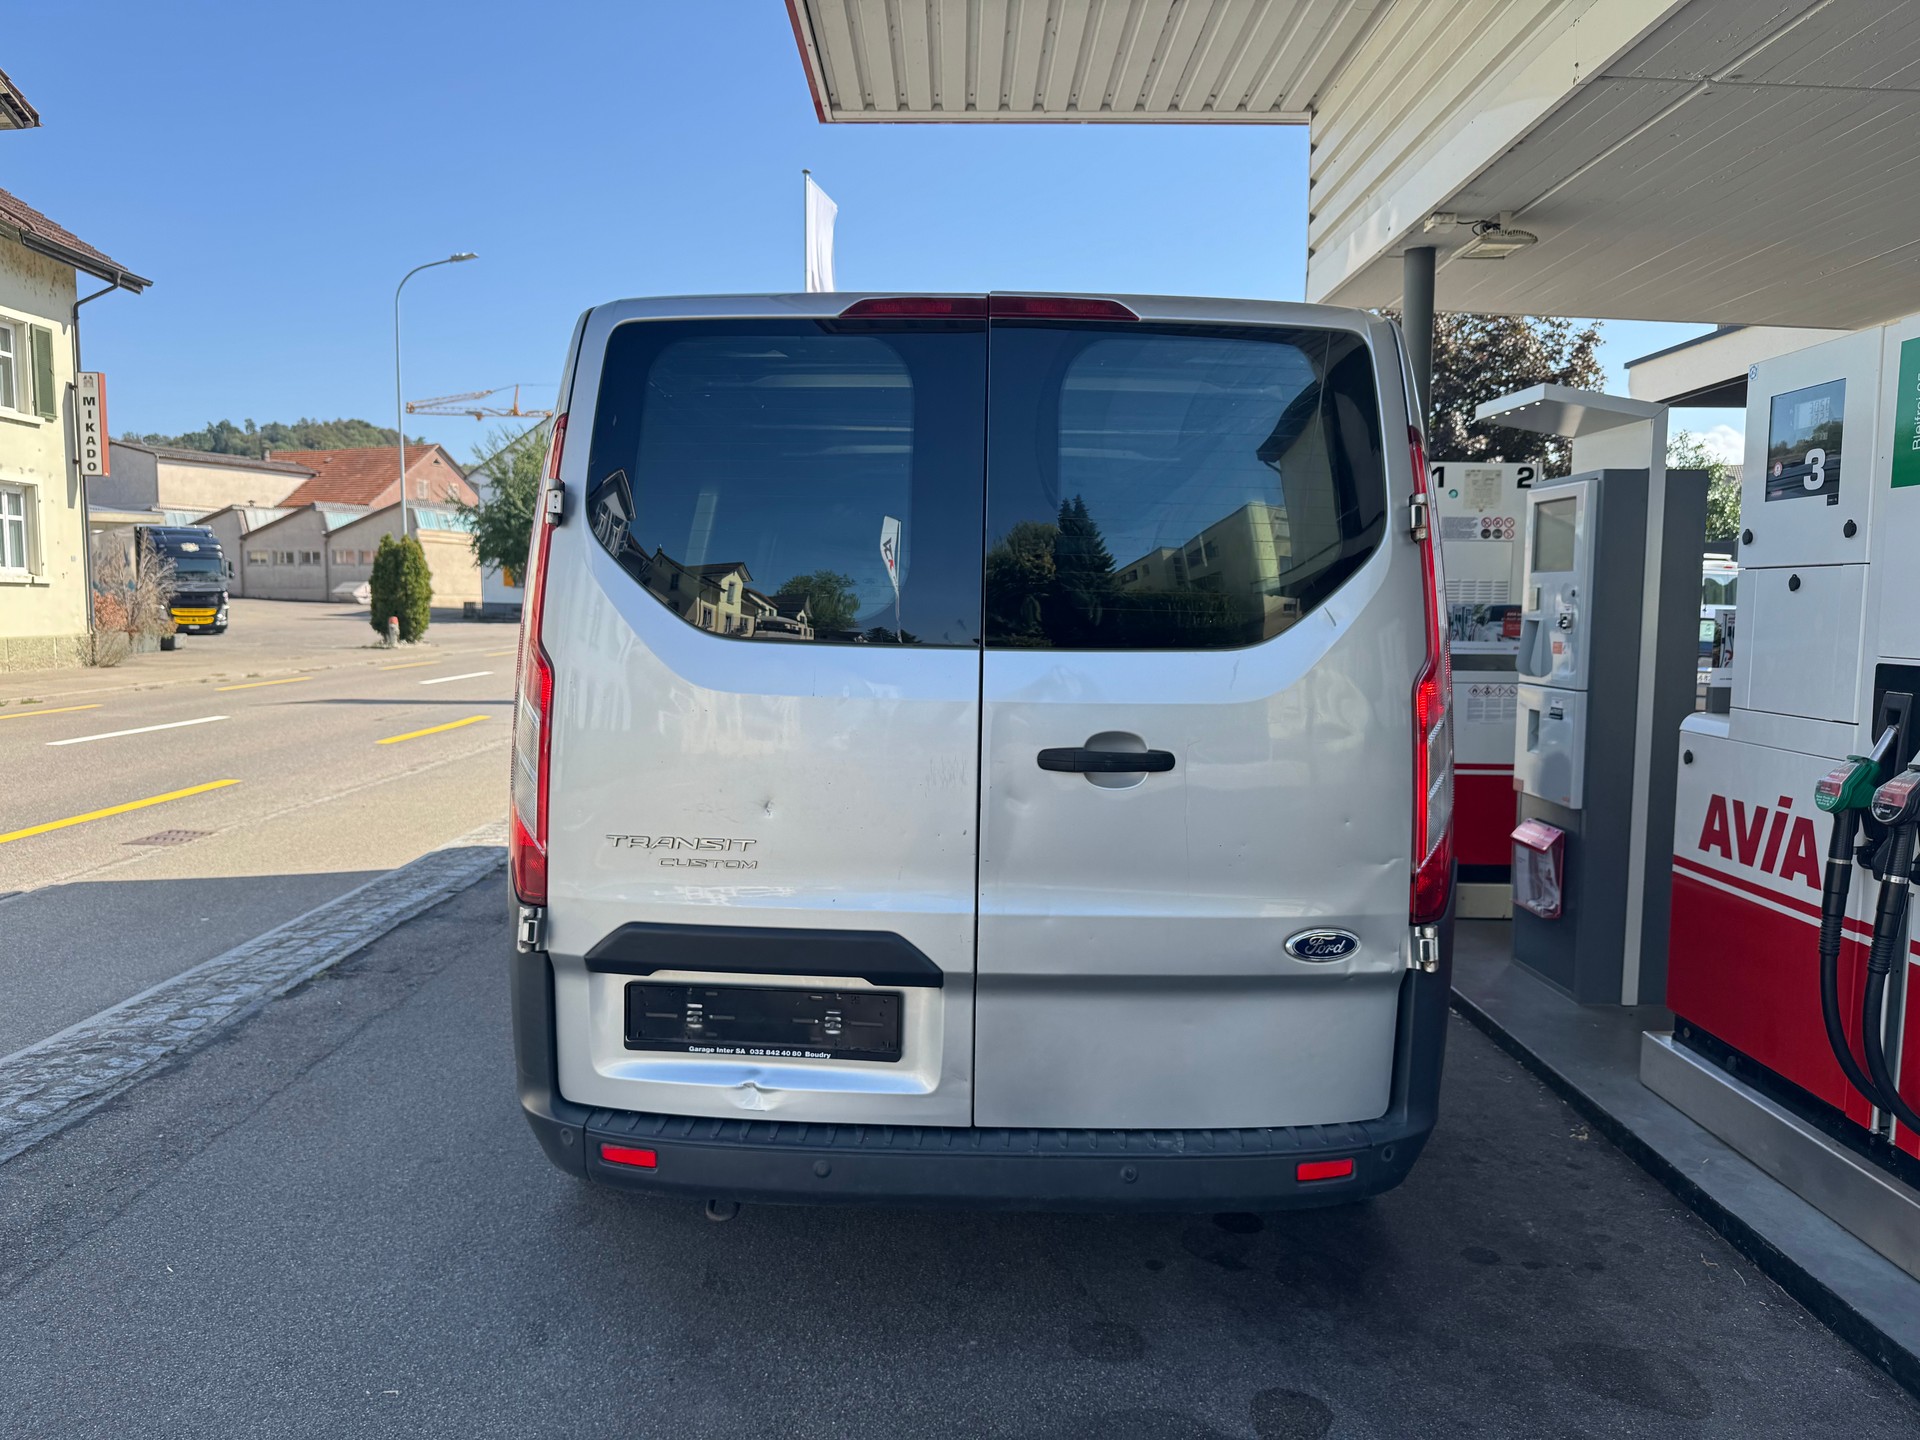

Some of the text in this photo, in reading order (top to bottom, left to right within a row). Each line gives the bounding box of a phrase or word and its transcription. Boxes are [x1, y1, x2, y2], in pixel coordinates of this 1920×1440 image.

[82, 397, 97, 471] MIKADO
[1432, 466, 1445, 488] 1
[1516, 466, 1534, 489] 2
[1803, 448, 1826, 490] 3
[605, 834, 757, 852] TRANSIT
[658, 857, 758, 869] CUSTOM
[1304, 936, 1346, 954] Ford
[688, 1045, 715, 1054] Garage
[716, 1046, 734, 1054] Inter
[805, 1051, 832, 1059] Boudry
